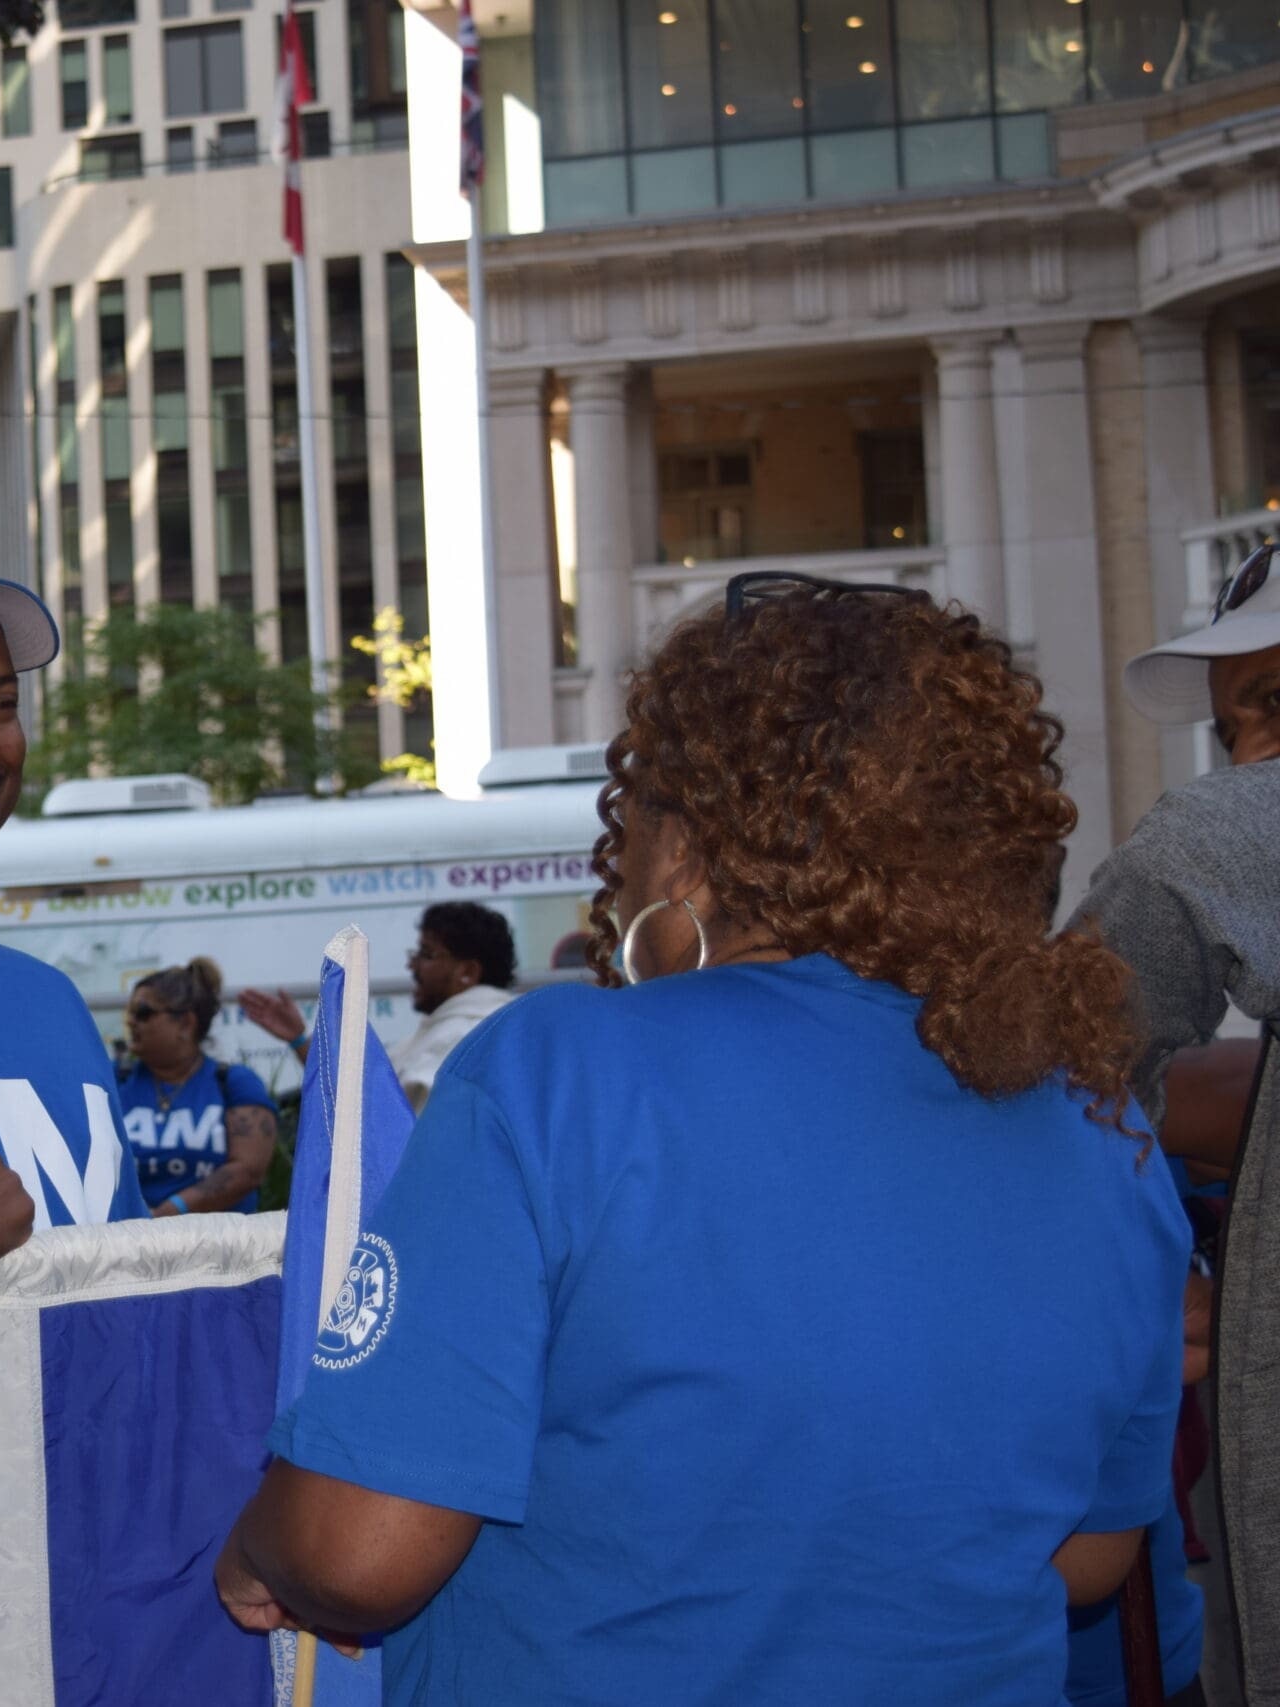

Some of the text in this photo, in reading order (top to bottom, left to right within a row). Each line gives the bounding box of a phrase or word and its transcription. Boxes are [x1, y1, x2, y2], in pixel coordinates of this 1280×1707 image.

[184, 872, 316, 909] explore
[326, 864, 436, 897] watch
[133, 1157, 214, 1179] ION
